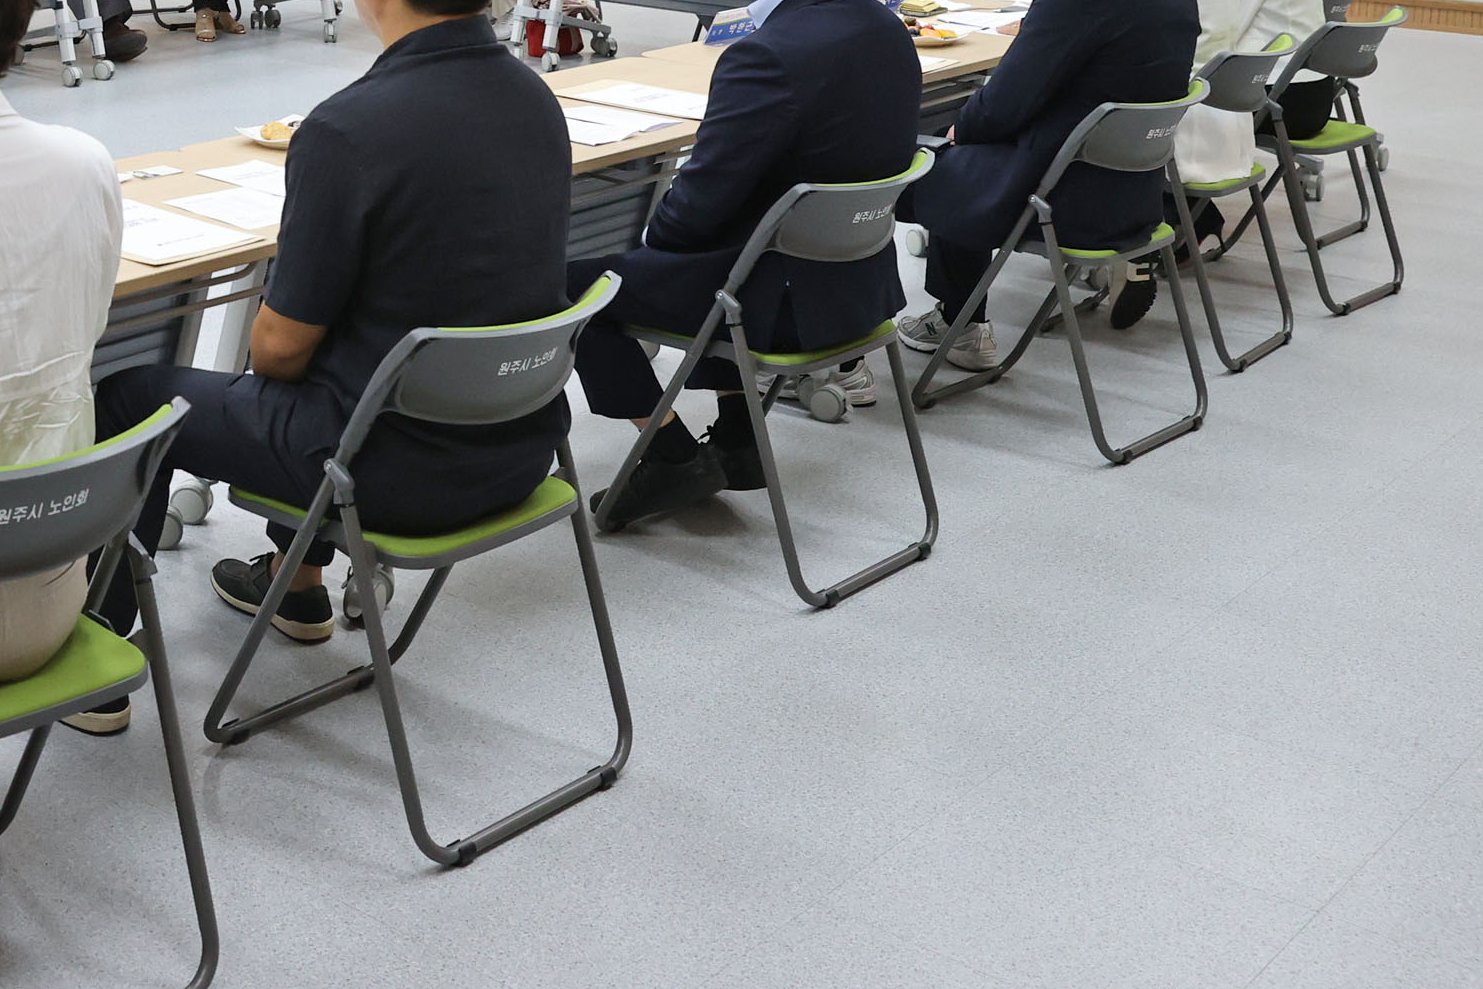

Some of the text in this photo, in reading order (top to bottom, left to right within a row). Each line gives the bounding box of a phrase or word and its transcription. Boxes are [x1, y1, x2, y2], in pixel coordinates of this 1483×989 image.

[852, 209, 877, 224] 원주시
[497, 357, 532, 376] 원주시
[48, 487, 90, 516] 노인회
